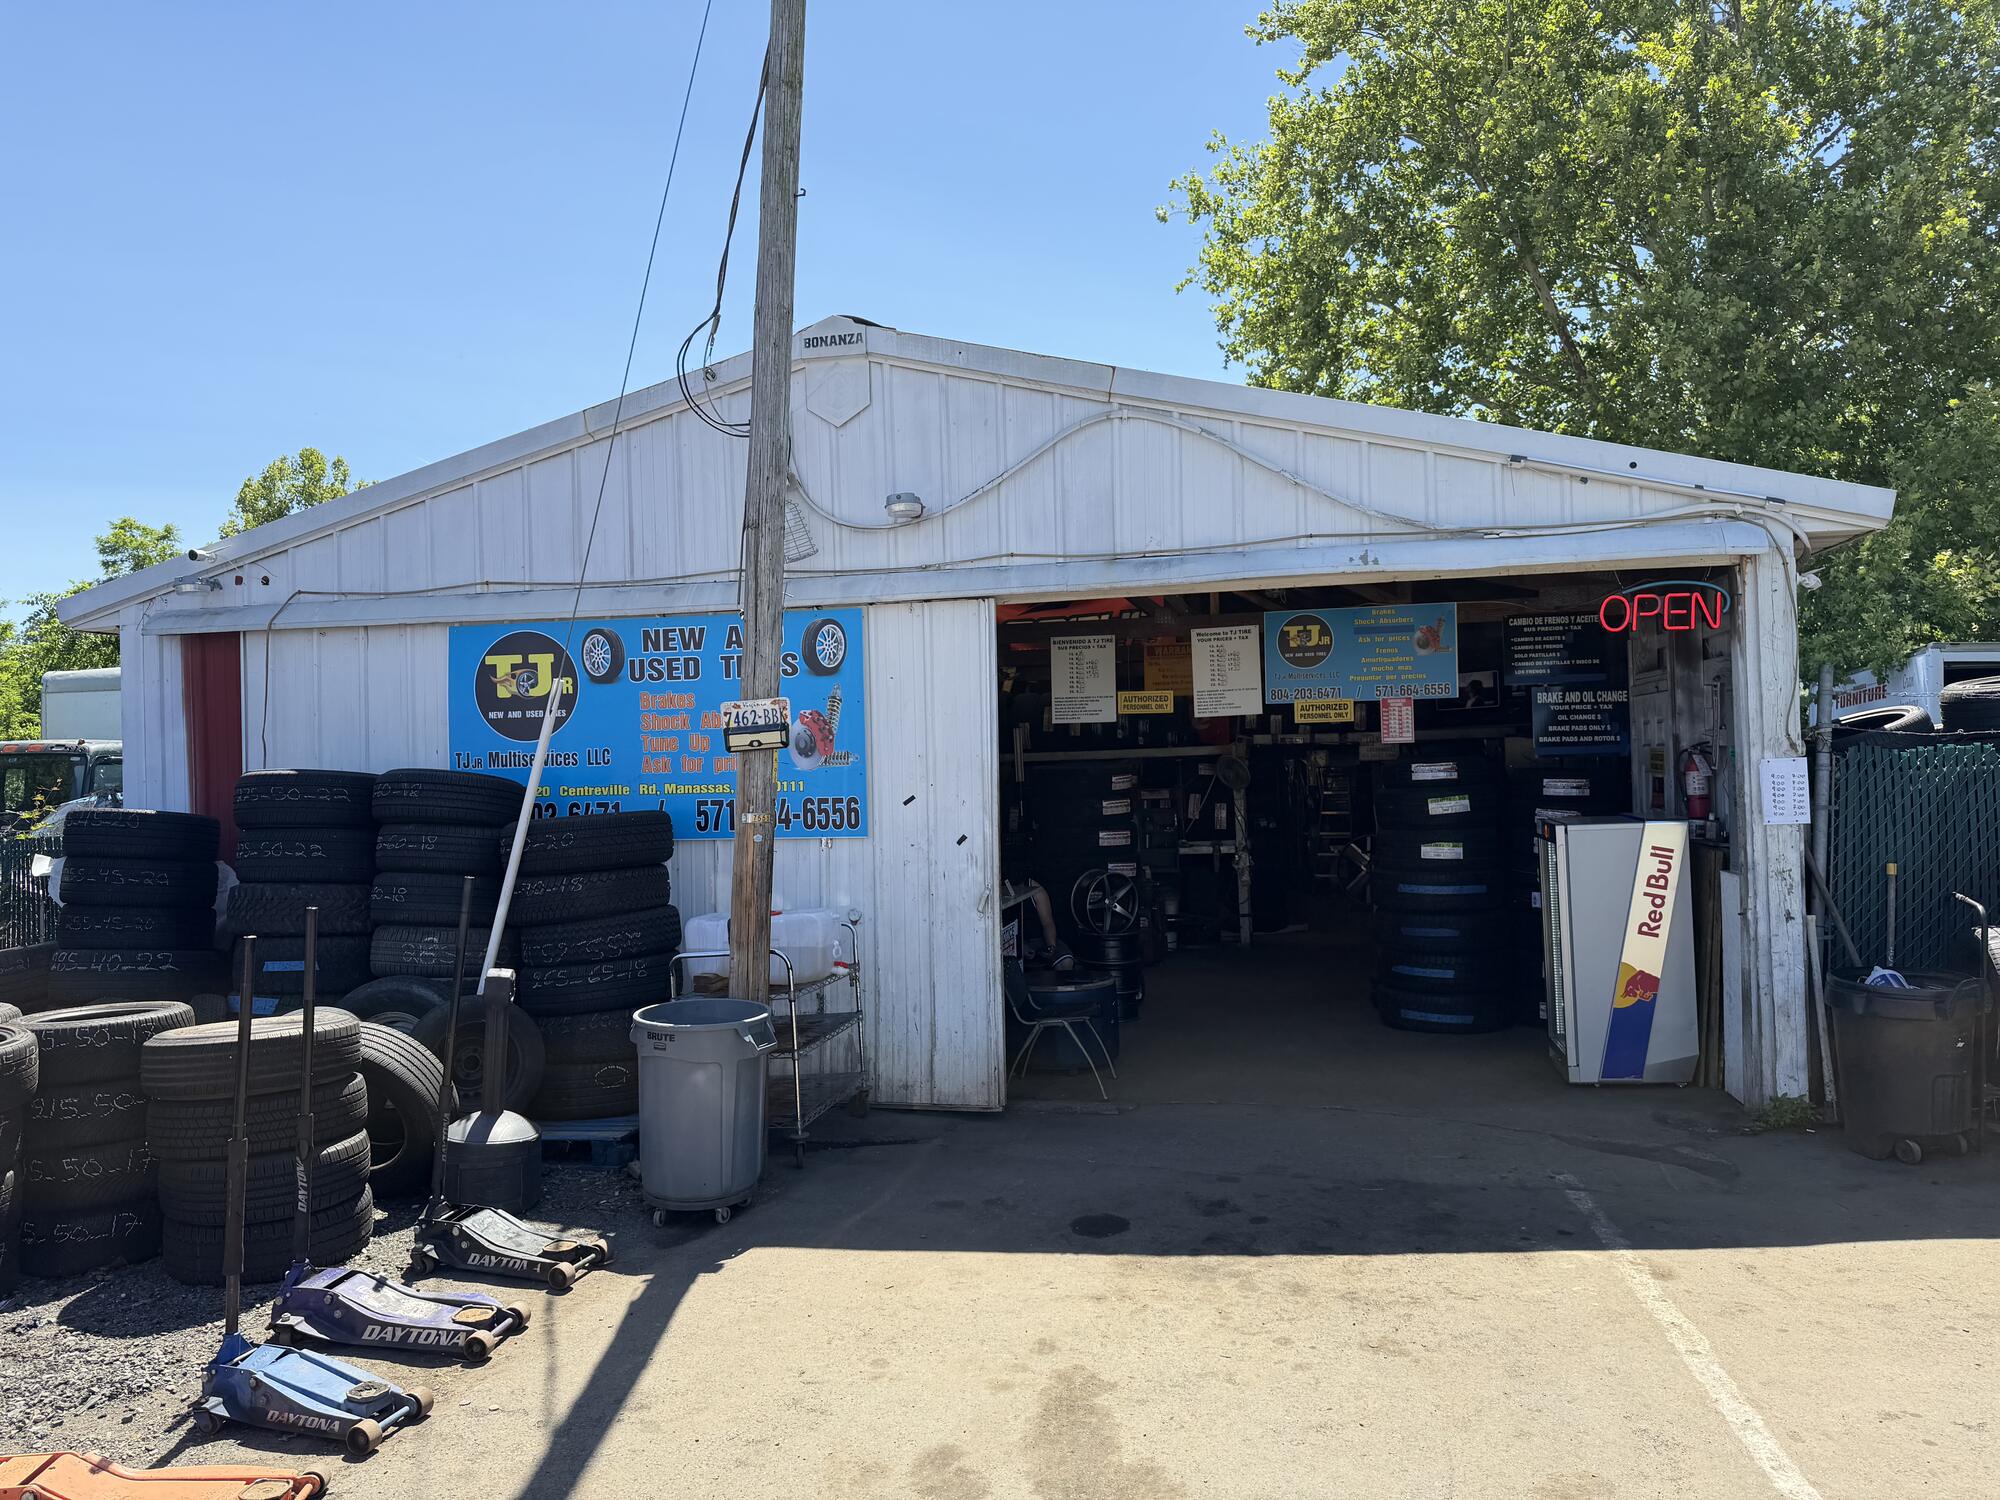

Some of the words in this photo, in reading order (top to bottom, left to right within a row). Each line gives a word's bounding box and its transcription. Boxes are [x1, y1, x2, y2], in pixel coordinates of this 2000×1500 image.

[804, 332, 864, 348] BONANZA
[1508, 617, 1534, 626] CAMBIO
[1534, 616, 1544, 625] DE
[1544, 616, 1569, 625] FRENOS
[1576, 614, 1599, 623] ACEITE
[1600, 591, 1722, 633] OPEN
[642, 626, 706, 653] NEW
[1283, 624, 1321, 648] TJ
[1319, 636, 1331, 646] JR
[629, 655, 701, 683] USED
[720, 652, 800, 679] TIS
[1123, 695, 1169, 703] AUTHORIZED
[1270, 686, 1342, 701] 804-203-6471
[1375, 682, 1451, 697] 571-664-6556
[1537, 692, 1564, 704] BRAKE
[1564, 691, 1581, 703] AND
[1582, 691, 1596, 703] OIL
[1596, 690, 1628, 702] CHANGE
[1835, 684, 1887, 709] FURNITURE
[639, 692, 695, 710] Brakes
[1300, 703, 1349, 712] AUTHORIZED
[489, 710, 504, 719] NEW
[508, 710, 522, 719] AND
[526, 710, 544, 718] USED
[640, 712, 690, 731] Shock
[641, 735, 679, 752] Tune
[689, 734, 710, 752] Up
[587, 748, 611, 766] LLC
[642, 756, 673, 773] Ask
[681, 755, 704, 773] for
[559, 784, 630, 796] Centreville
[639, 784, 661, 796] Rd,
[664, 781, 735, 796] Manassas,
[647, 1031, 676, 1042] BRUTE
[361, 1325, 468, 1347] DAYTONA
[266, 1409, 340, 1433] DAYTONA
